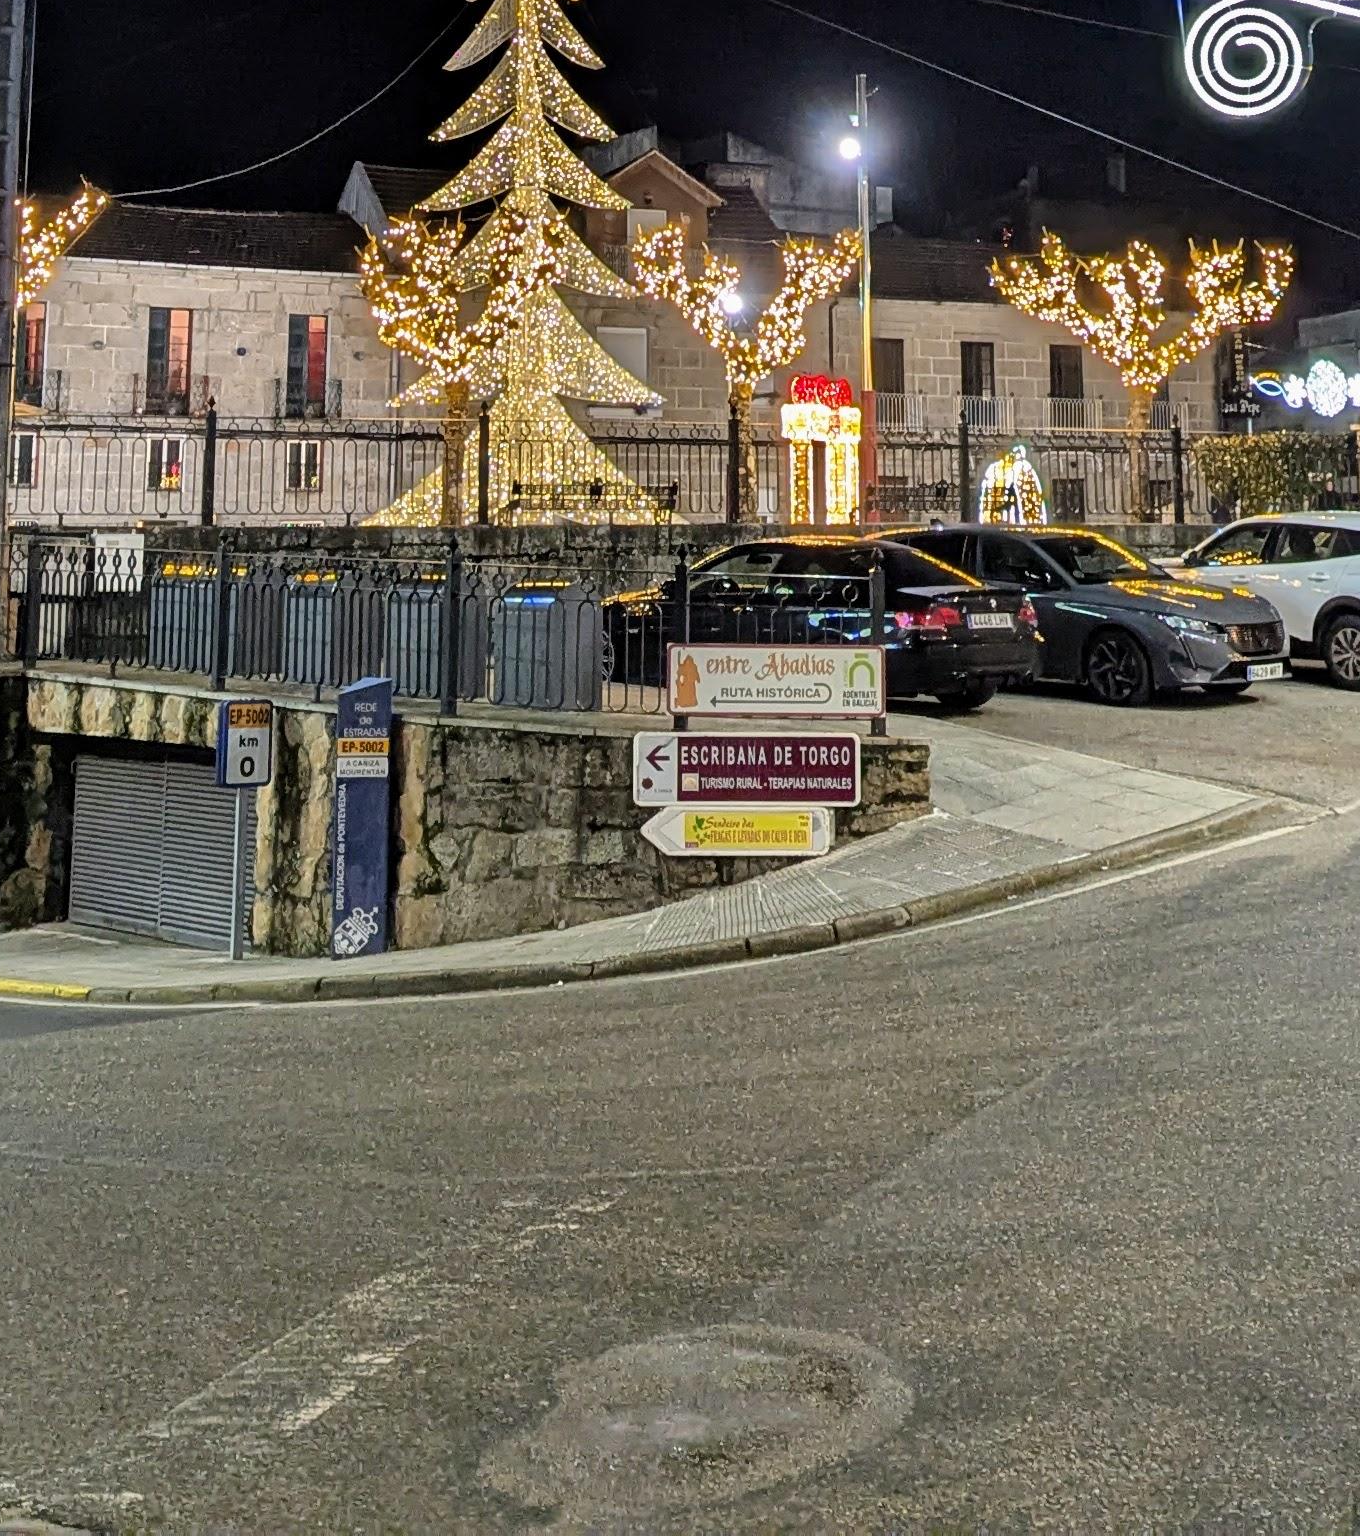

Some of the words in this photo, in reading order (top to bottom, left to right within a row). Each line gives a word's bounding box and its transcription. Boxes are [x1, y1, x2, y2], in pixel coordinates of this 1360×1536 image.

[706, 655, 752, 675] entre
[720, 687, 753, 698] RUTA
[756, 685, 821, 698] HISTÓRICA
[354, 702, 378, 713] REDE
[230, 708, 270, 725] EP-5002
[359, 716, 373, 725] de
[343, 727, 388, 737] ESTRADAS
[239, 734, 259, 747] km
[341, 741, 385, 753] EP-5002
[680, 745, 767, 765] ESCRIBANA
[773, 745, 793, 765] DE
[799, 745, 851, 766] TORGO
[240, 756, 255, 777] 0
[700, 776, 736, 790] TURISMO
[736, 776, 763, 790] RURAL
[768, 776, 806, 790] TERAPIAS
[806, 776, 853, 791] NATURALES
[337, 783, 347, 842] PONTEVEDRA
[705, 815, 741, 828] Sendeiro
[741, 817, 755, 828] das
[338, 843, 346, 854] de
